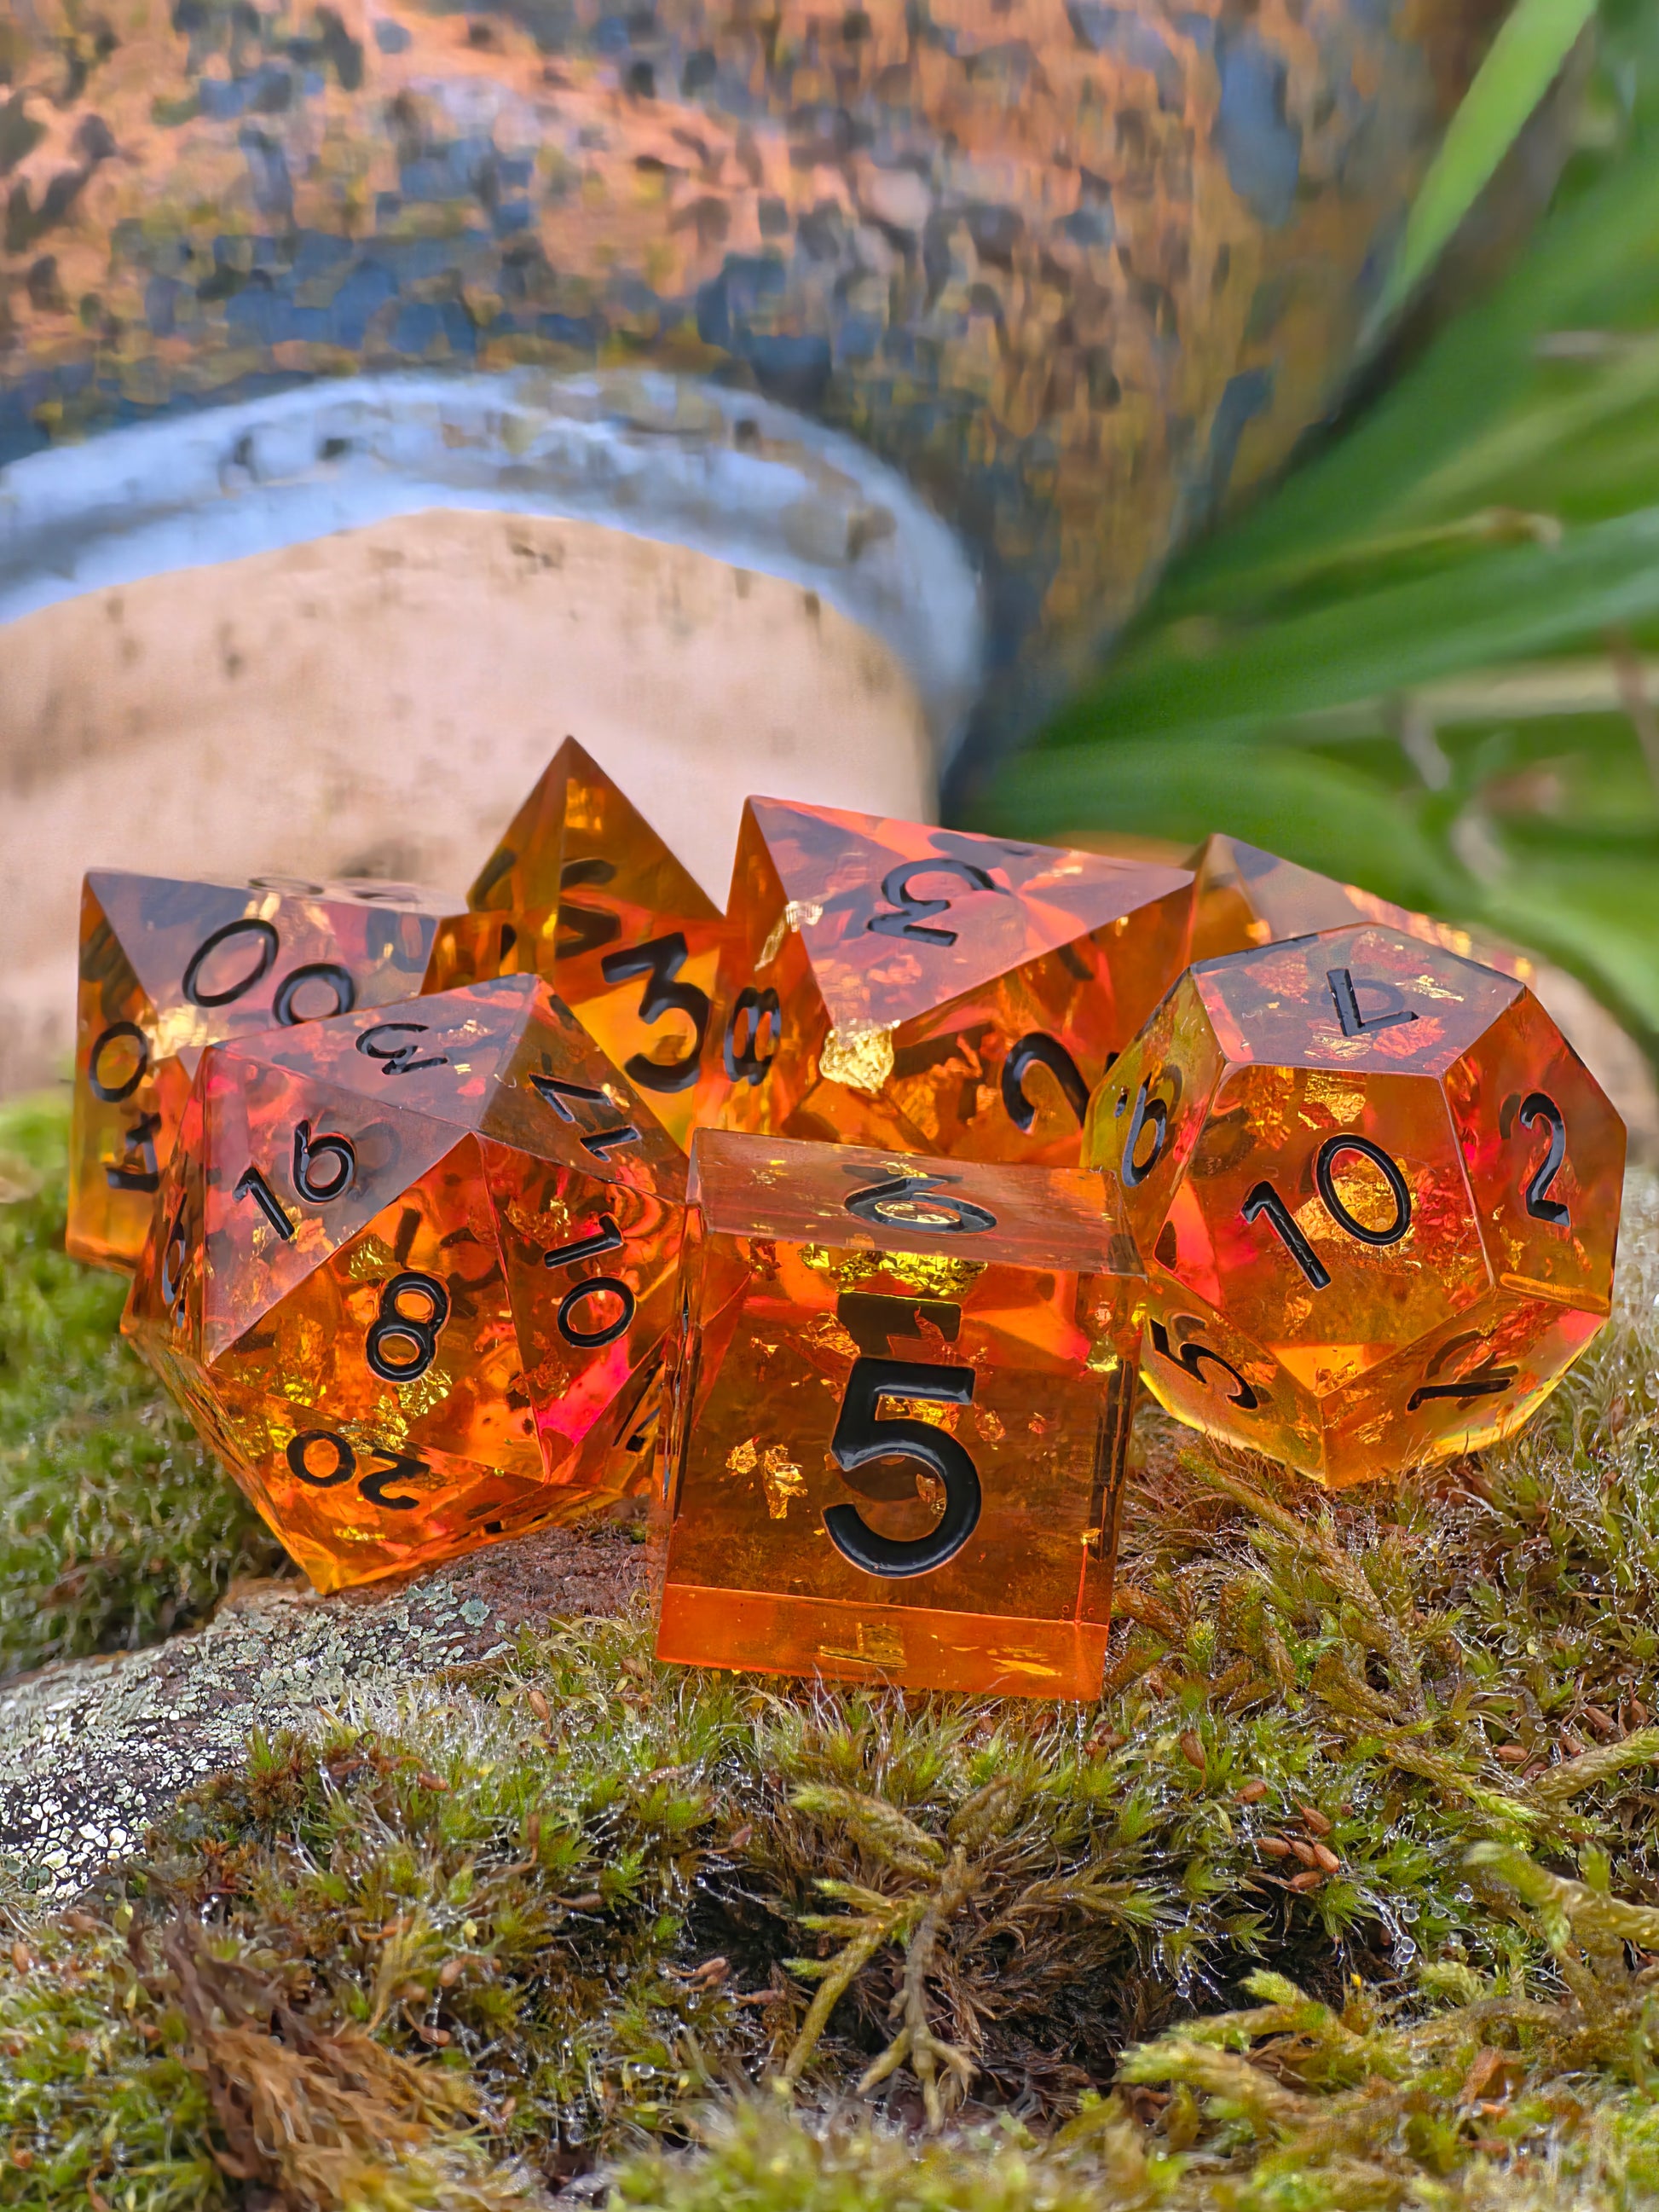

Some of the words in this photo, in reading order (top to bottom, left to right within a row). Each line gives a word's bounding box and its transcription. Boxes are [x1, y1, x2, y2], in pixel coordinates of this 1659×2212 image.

[601, 931, 710, 1093] 3
[1326, 969, 1419, 1038] 7
[529, 1073, 641, 1162] 17
[1519, 1092, 1570, 1227] 2
[233, 1119, 356, 1241] 16
[844, 1176, 997, 1234] 6
[1241, 1133, 1413, 1291] 10
[366, 1271, 452, 1383] 8
[543, 1213, 637, 1349] 10
[1149, 1317, 1258, 1410] 5
[286, 1428, 432, 1510] 20
[822, 1357, 982, 1578] 5
